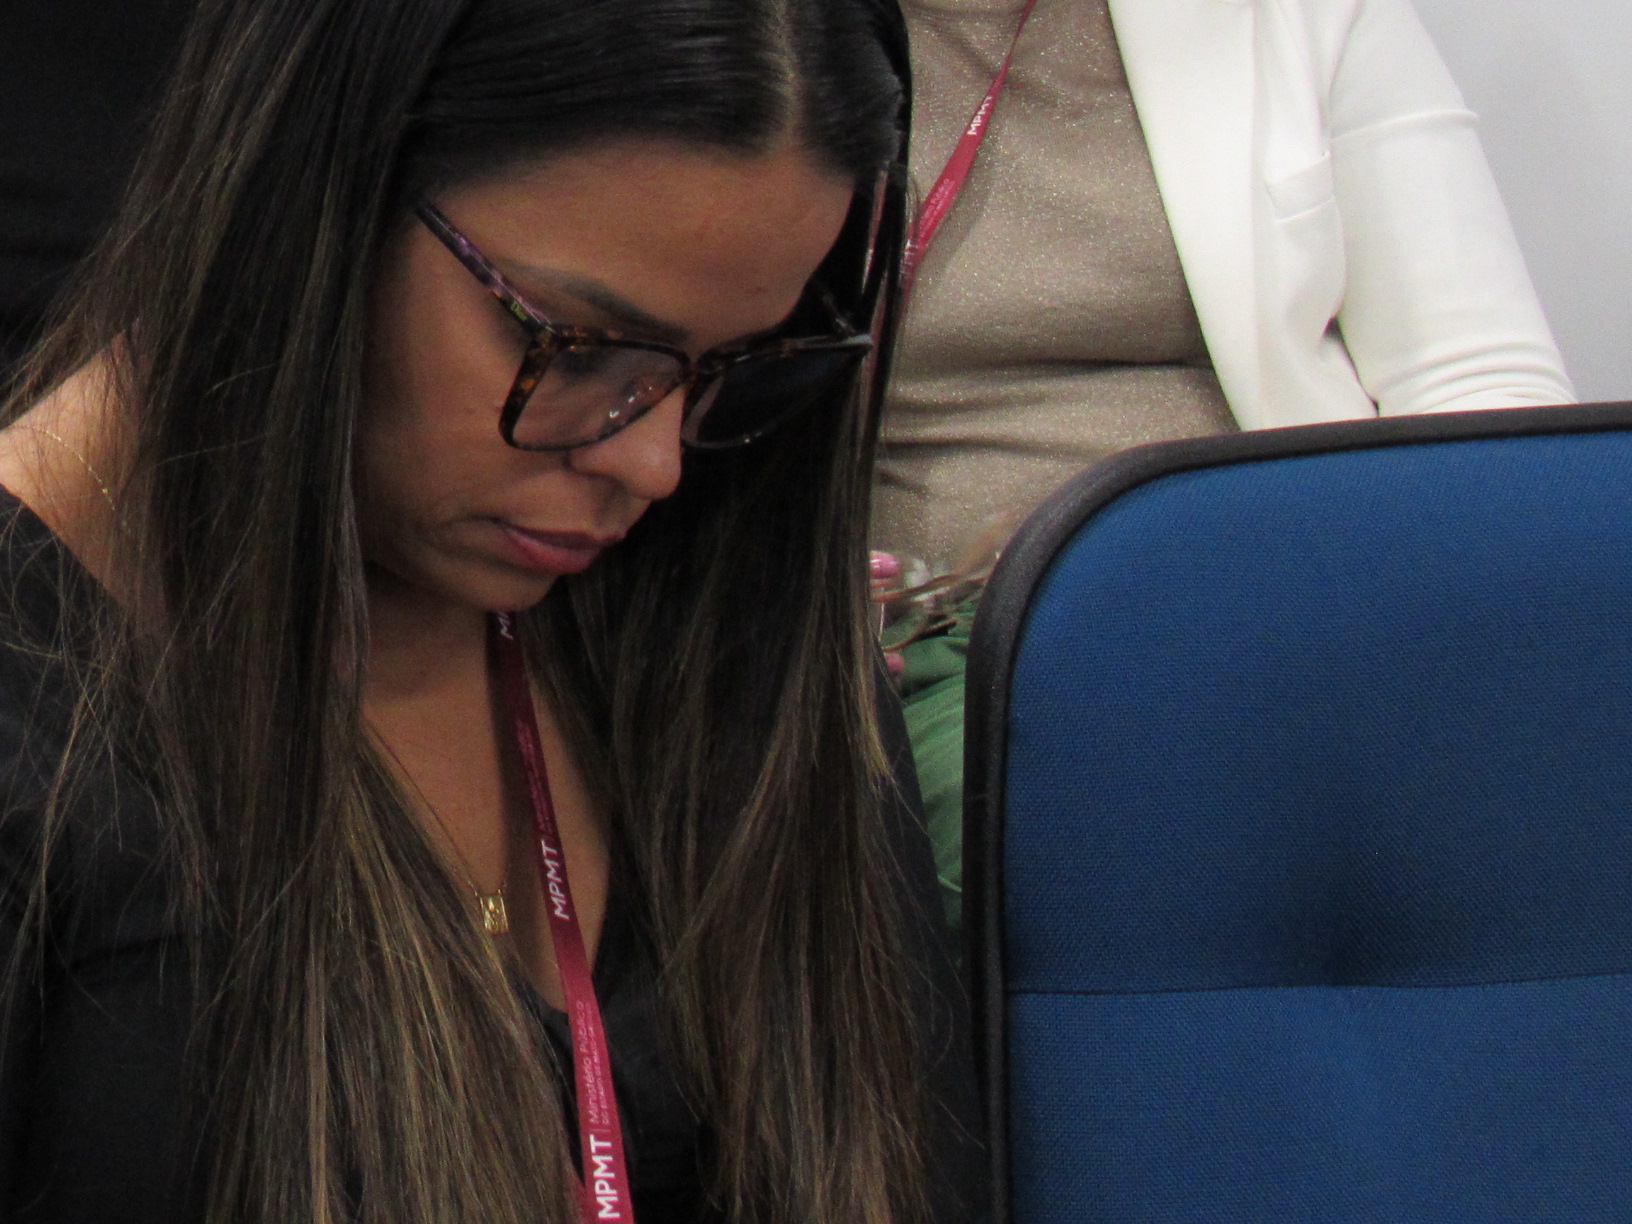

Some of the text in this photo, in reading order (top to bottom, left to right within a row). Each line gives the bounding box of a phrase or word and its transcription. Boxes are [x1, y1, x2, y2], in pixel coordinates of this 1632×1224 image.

[541, 839, 570, 920] MPMT
[575, 1000, 599, 1124] Ministério Público
[589, 1134, 620, 1219] MPMT
